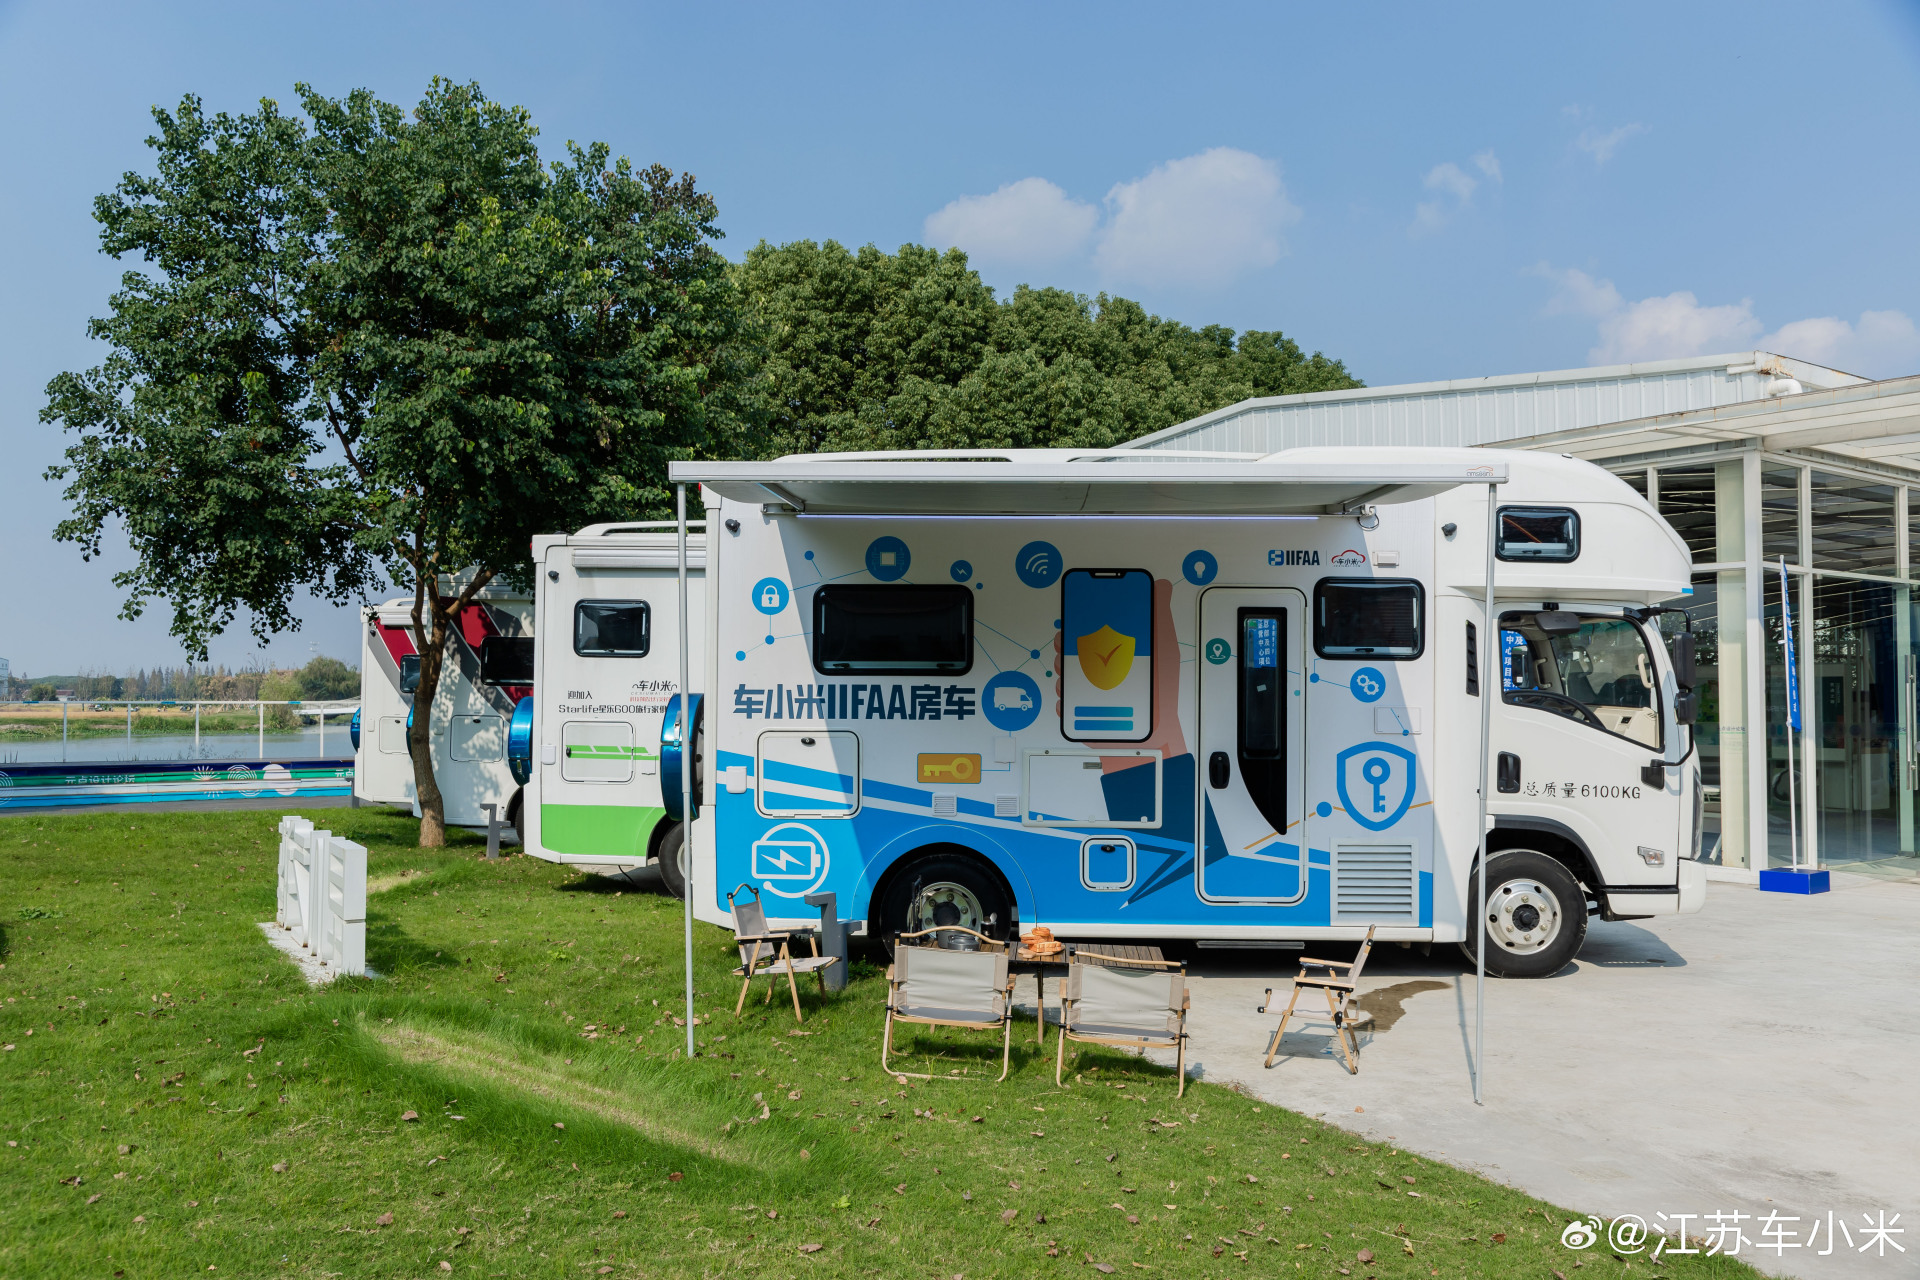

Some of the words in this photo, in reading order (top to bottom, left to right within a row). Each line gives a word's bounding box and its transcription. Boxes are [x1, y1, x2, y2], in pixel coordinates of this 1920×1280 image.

[1286, 550, 1320, 566] IIFAA
[1336, 558, 1359, 566] 车小米
[635, 680, 674, 691] 车小米
[733, 683, 976, 721] 车小米IIFAA房车
